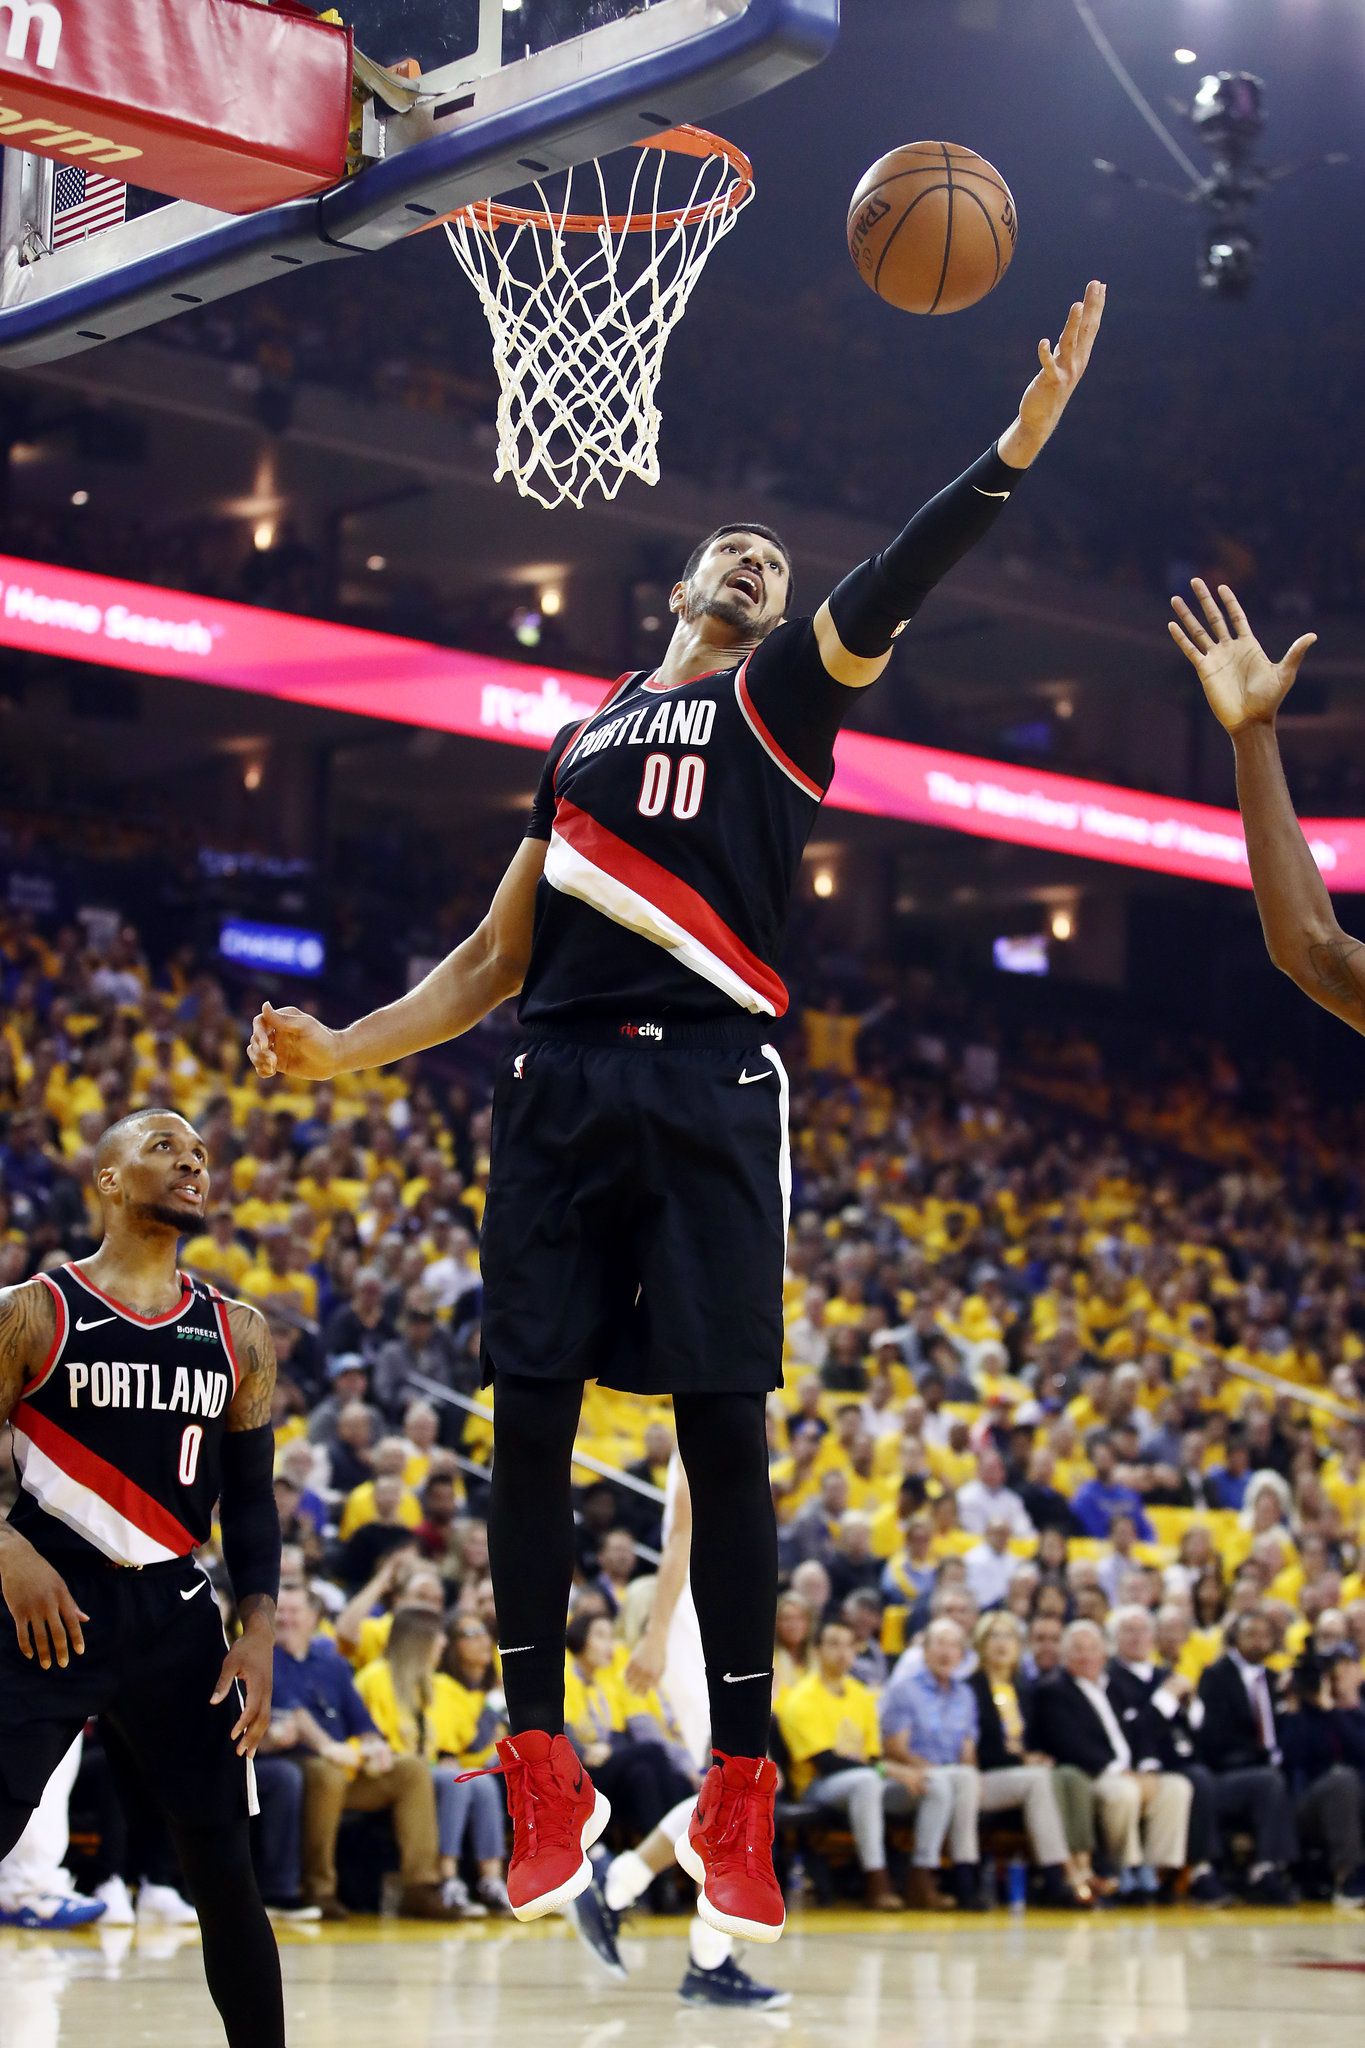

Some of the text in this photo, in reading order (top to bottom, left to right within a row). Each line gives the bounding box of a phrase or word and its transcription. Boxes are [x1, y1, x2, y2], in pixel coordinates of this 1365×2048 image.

[568, 700, 717, 769] PORTLAND
[637, 752, 706, 820] 00
[65, 1361, 228, 1419] PORTLAND
[178, 1424, 202, 1486] 0
